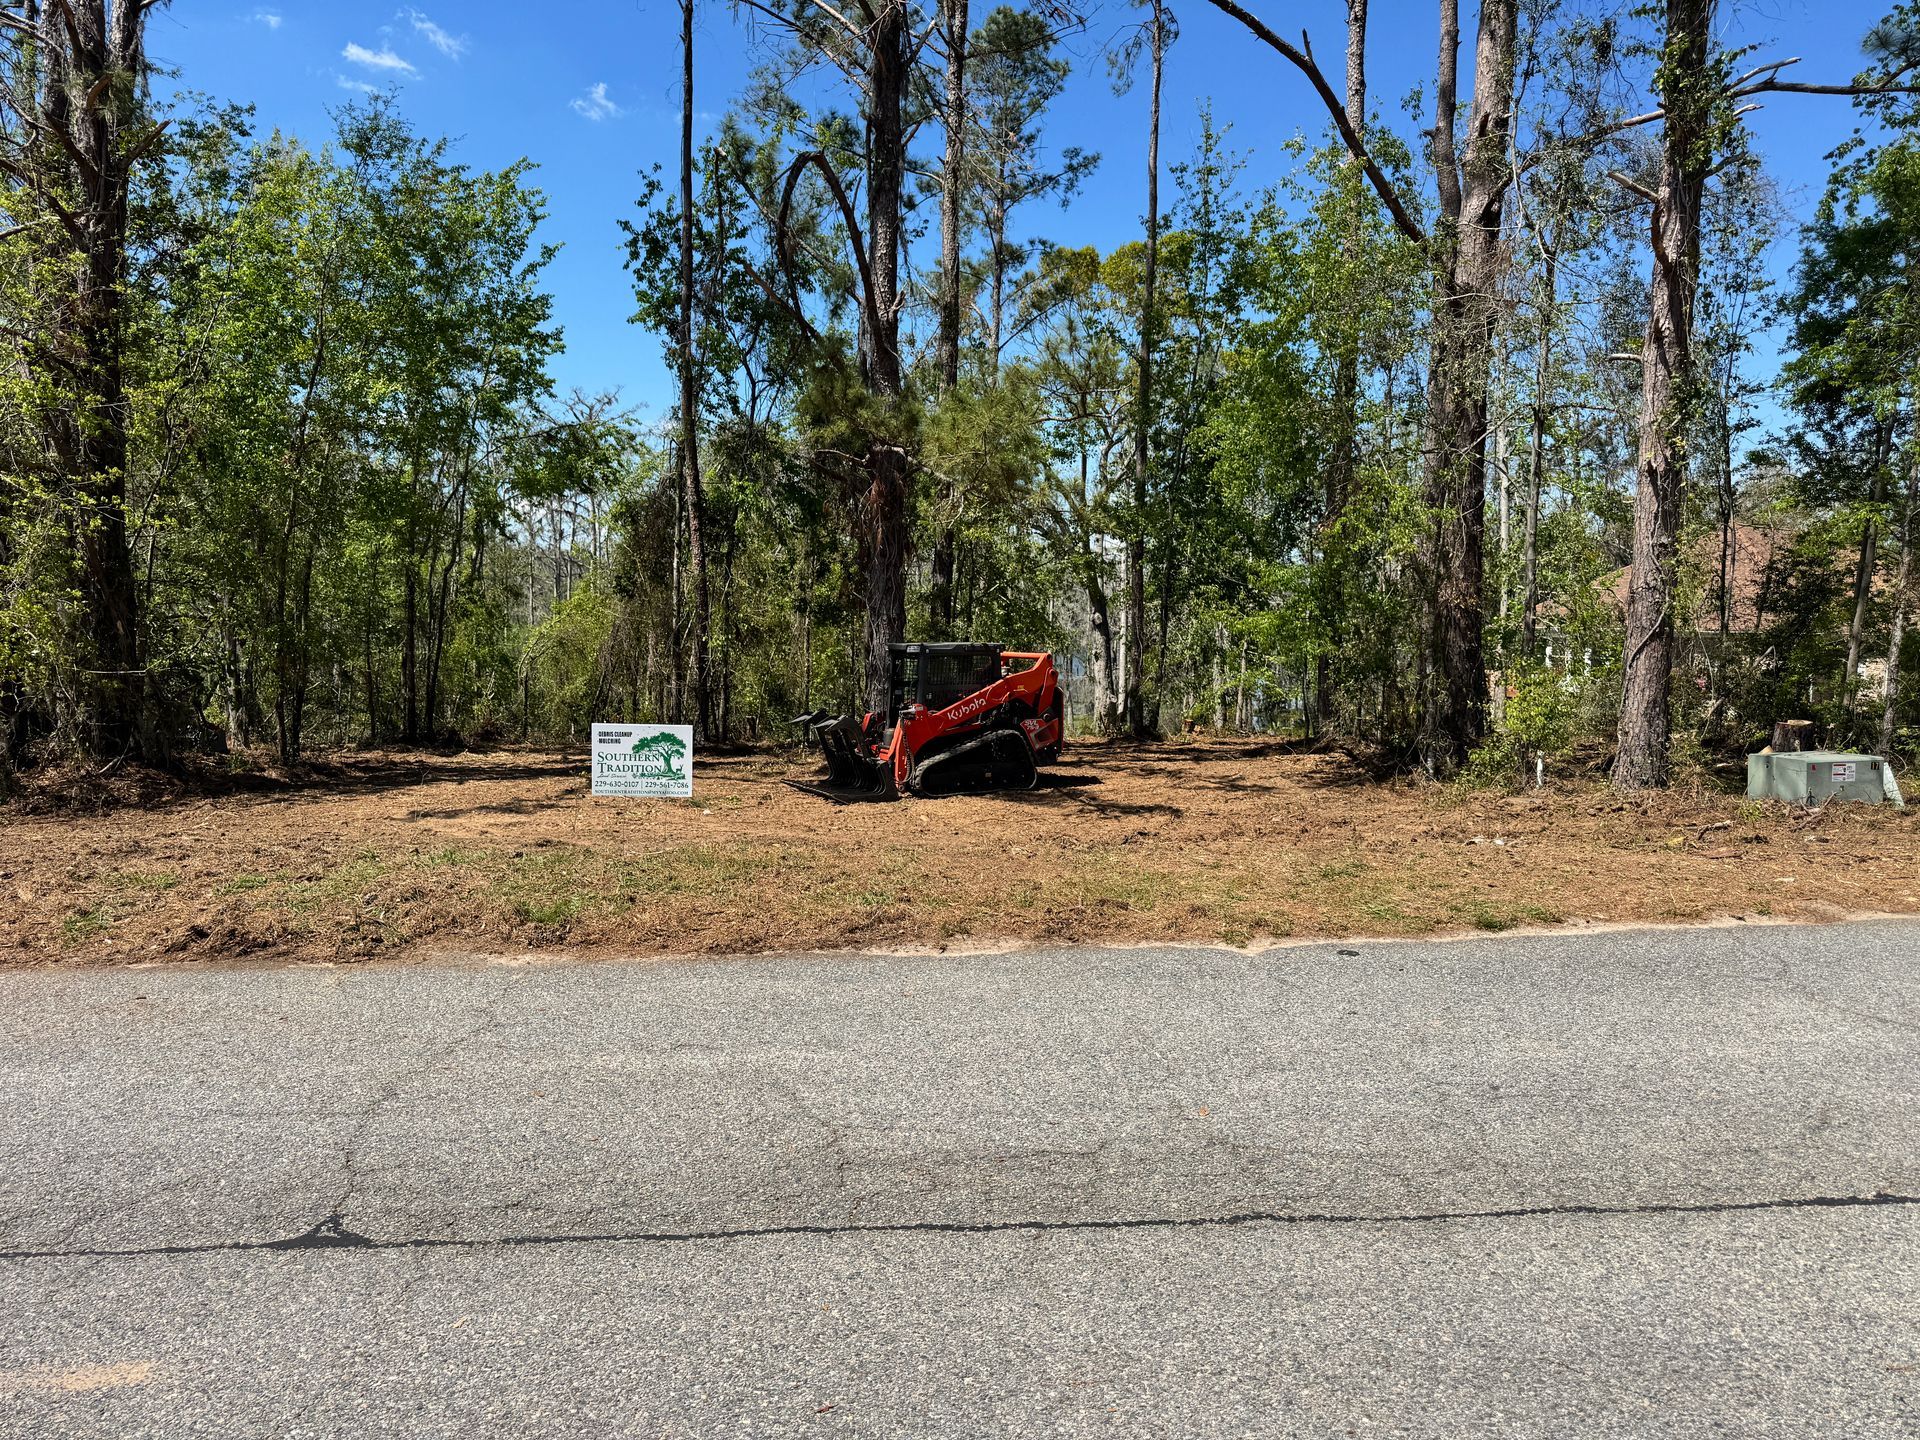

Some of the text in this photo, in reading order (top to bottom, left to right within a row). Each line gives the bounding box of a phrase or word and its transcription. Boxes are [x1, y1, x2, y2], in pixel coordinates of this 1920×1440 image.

[947, 698, 986, 719] Kubota
[597, 751, 660, 763] SOUTHERN
[597, 762, 662, 774] TRADITION
[594, 780, 689, 789] 229-630-0107 229-561-7086
